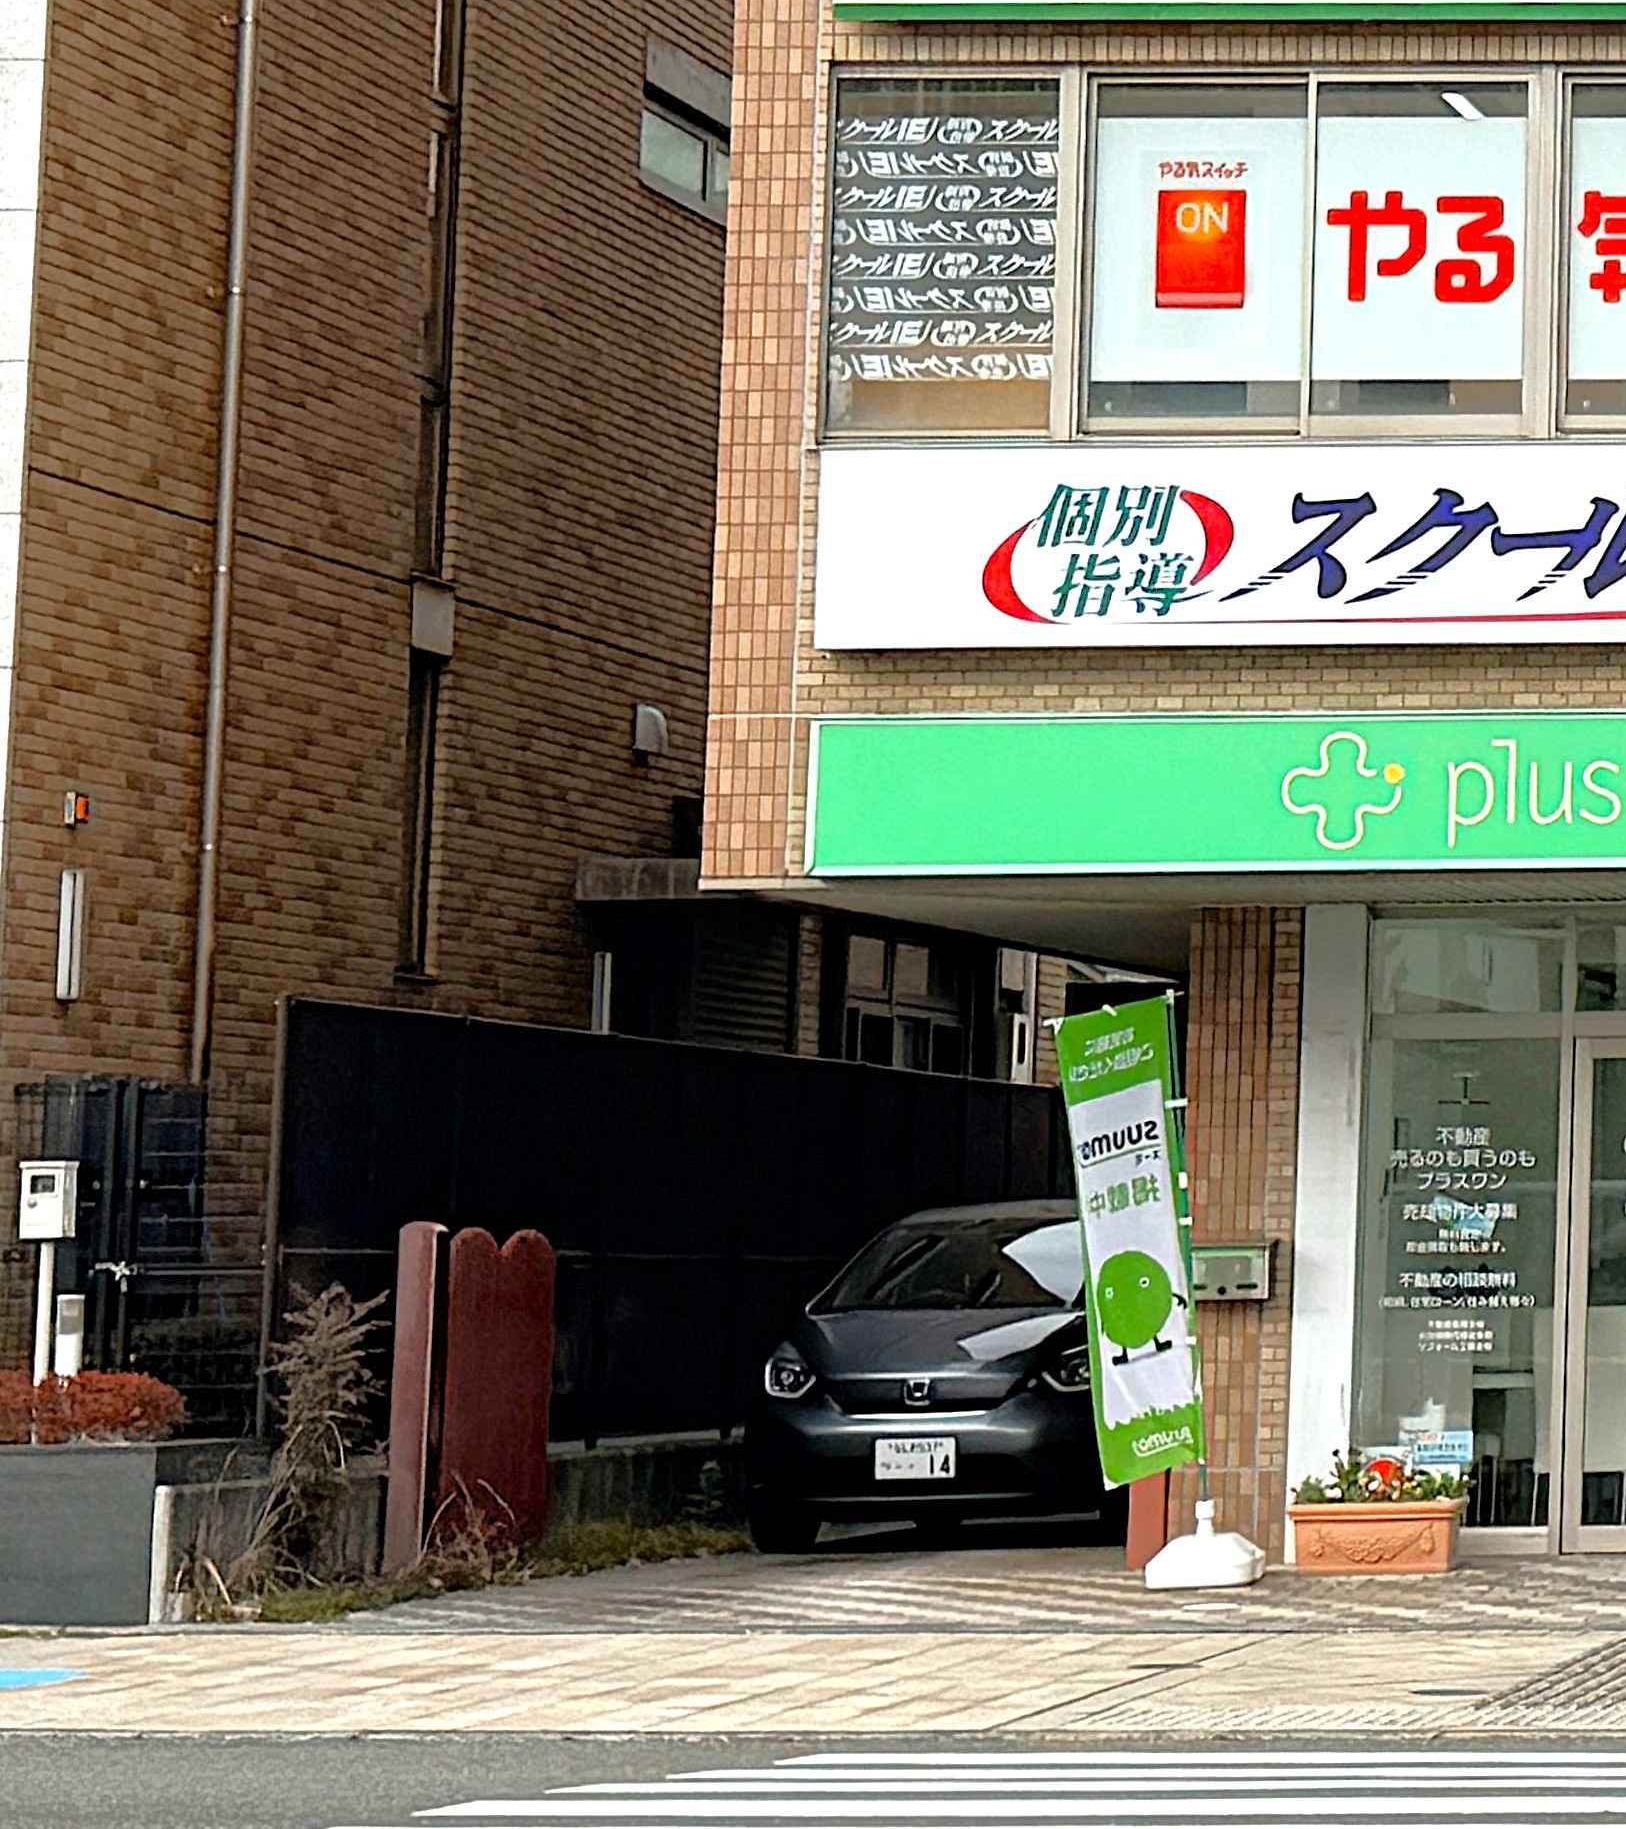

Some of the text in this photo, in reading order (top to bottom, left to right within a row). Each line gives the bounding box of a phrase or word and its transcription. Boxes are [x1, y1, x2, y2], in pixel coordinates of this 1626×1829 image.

[1158, 161, 1249, 180] やる気スイッチ
[1176, 201, 1229, 234] ON
[1036, 484, 1180, 548] 個別
[1050, 552, 1208, 617] 指導
[1449, 739, 1624, 848] plus
[1435, 1127, 1490, 1146] 不動産
[1391, 1149, 1536, 1168] 売るのも買うのも
